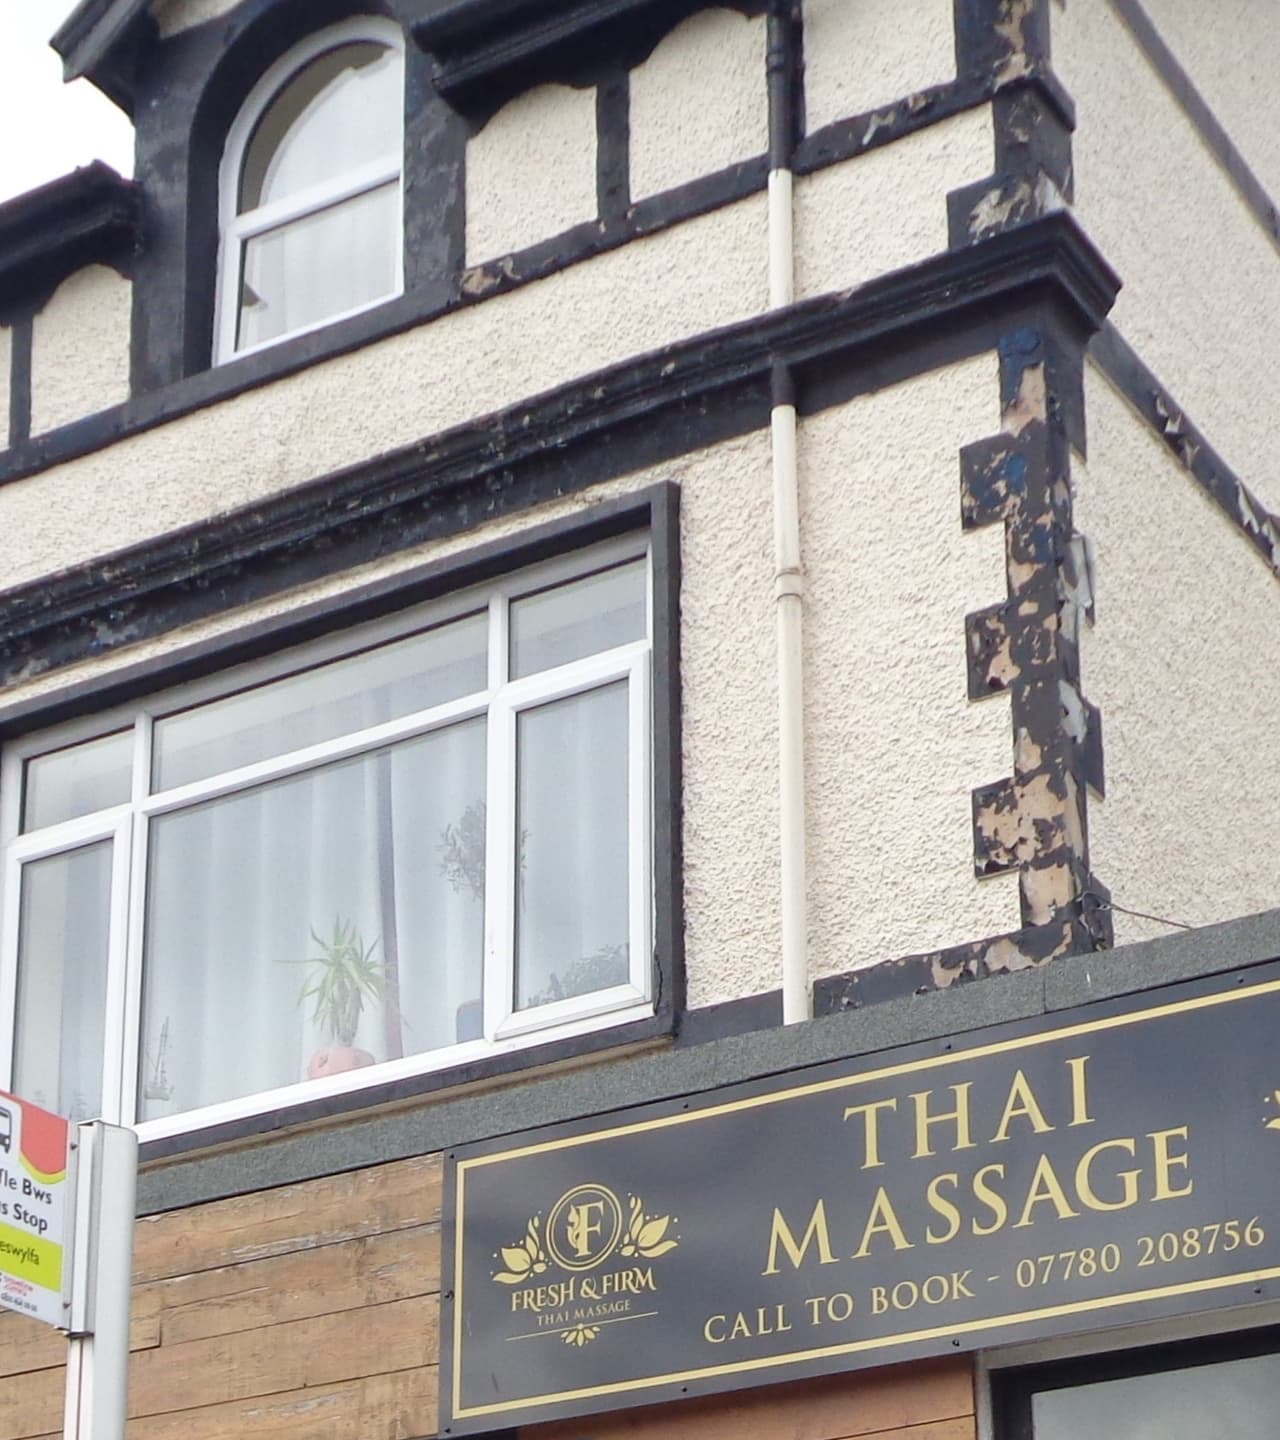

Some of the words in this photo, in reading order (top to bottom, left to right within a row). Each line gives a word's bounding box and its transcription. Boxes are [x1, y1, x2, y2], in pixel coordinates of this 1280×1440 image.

[843, 1055, 1096, 1171] THAI
[23, 1179, 53, 1205] Bws
[761, 1125, 1193, 1277] MASSAGE
[13, 1203, 48, 1235] Stop
[511, 1276, 575, 1312] FRESH
[580, 1278, 601, 1299] &
[602, 1267, 656, 1295] FIRM
[703, 1303, 792, 1344] CALL
[805, 1292, 853, 1325] TO
[870, 1270, 976, 1315] BOOK
[1015, 1243, 1120, 1288] 07780
[1136, 1215, 1266, 1268] 208756
[536, 1310, 569, 1327] THAI
[574, 1300, 631, 1320] MASSAGE
